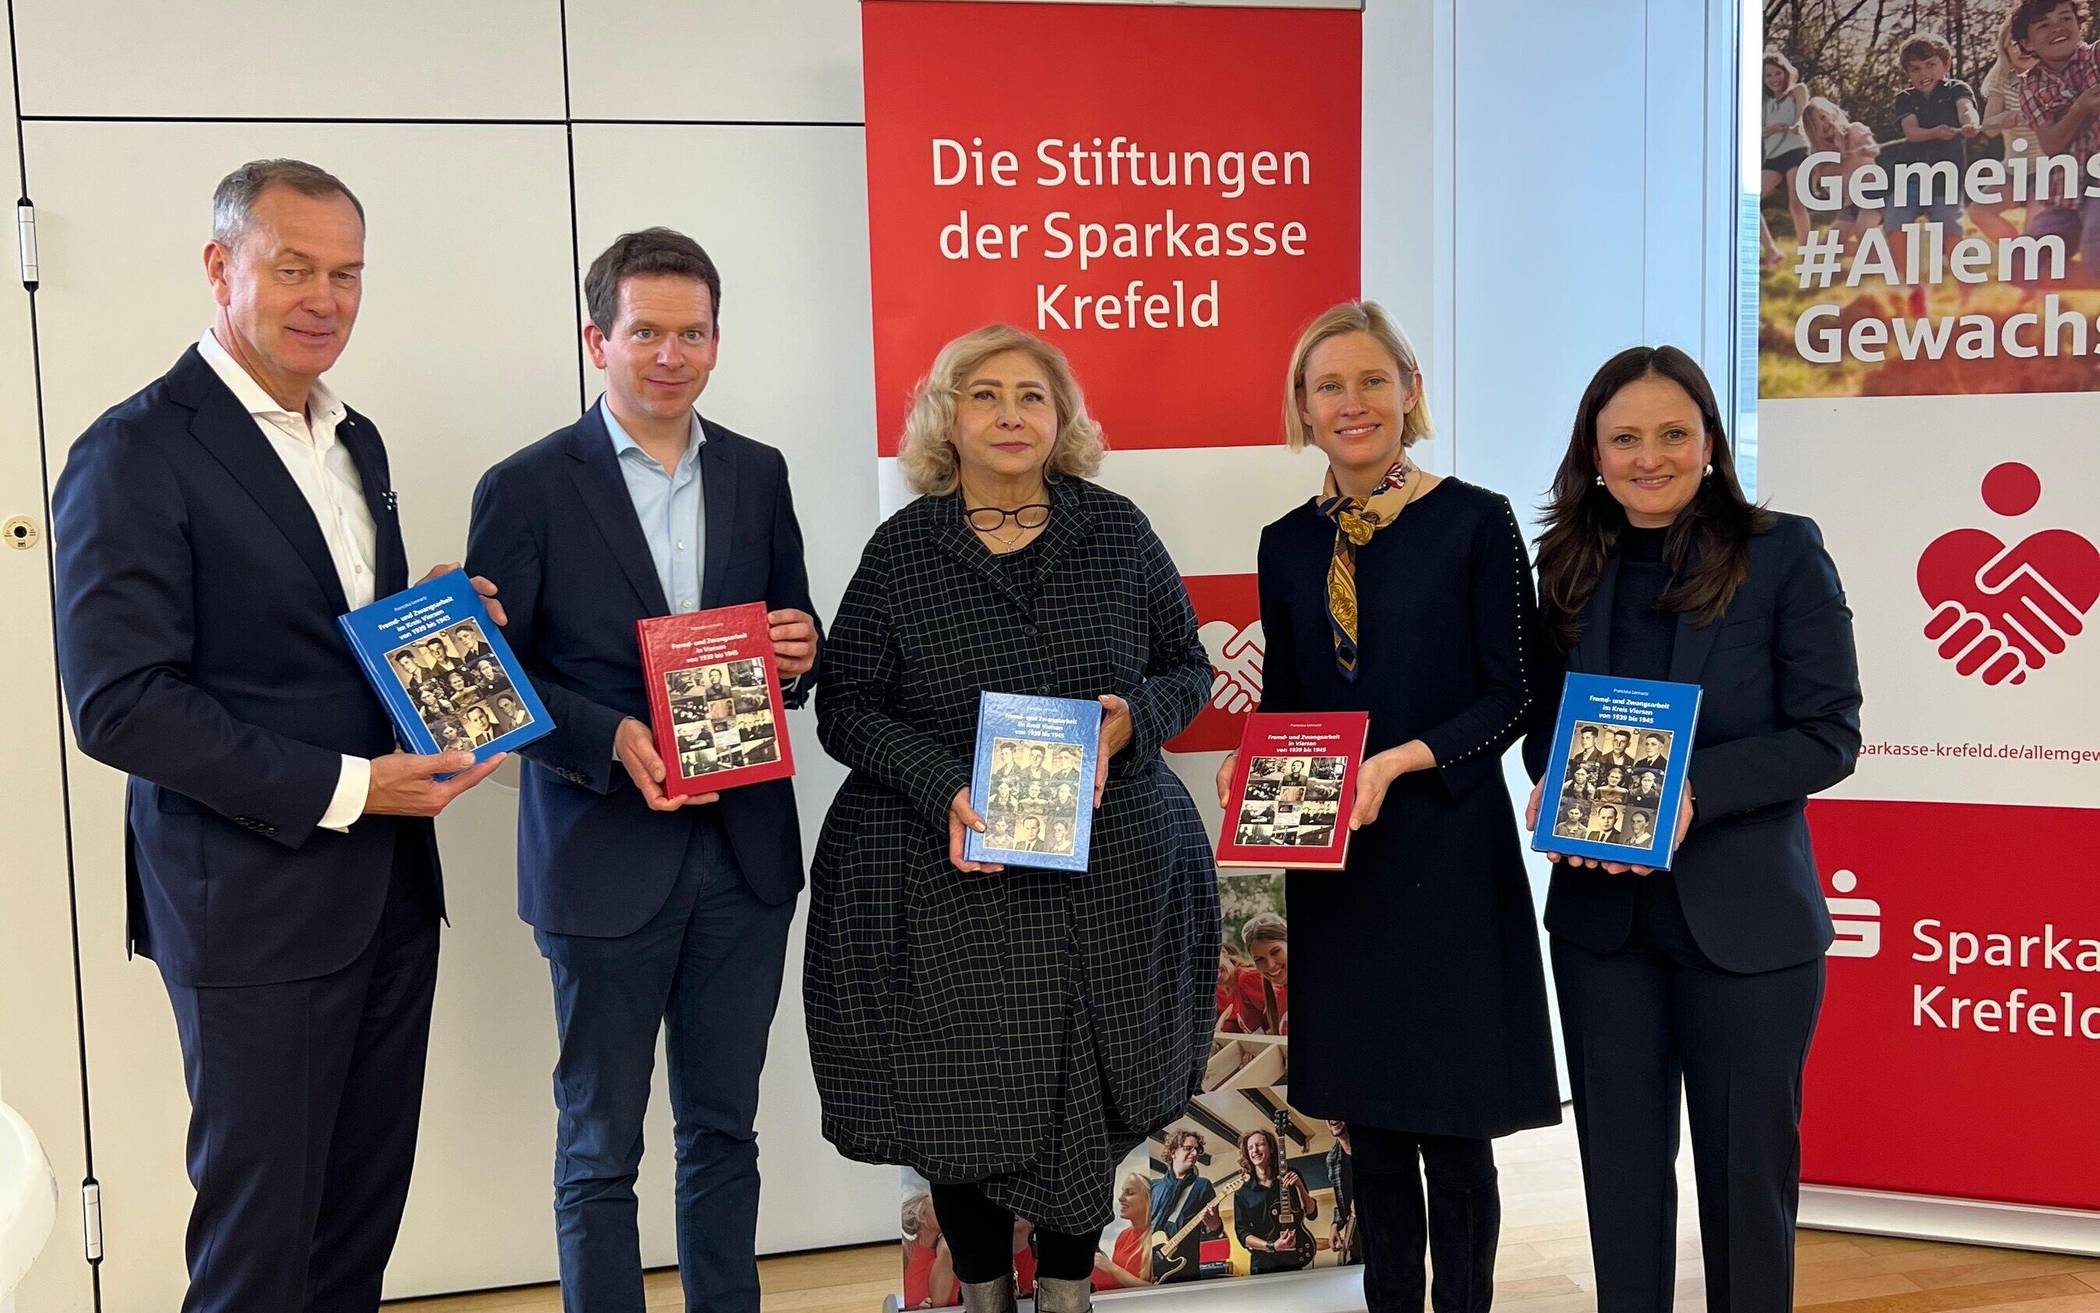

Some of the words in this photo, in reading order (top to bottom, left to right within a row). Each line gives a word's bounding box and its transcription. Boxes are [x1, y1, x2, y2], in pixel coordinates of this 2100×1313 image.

[931, 136, 1019, 187] Die
[1036, 136, 1311, 198] Stiftungen
[939, 209, 1029, 260] der
[1043, 209, 1308, 270] Sparkasse
[1794, 221, 2066, 289] #Allem
[1037, 280, 1220, 331] Krefeld
[1794, 294, 2100, 364] Gewach
[1912, 918, 2100, 975] Sparka
